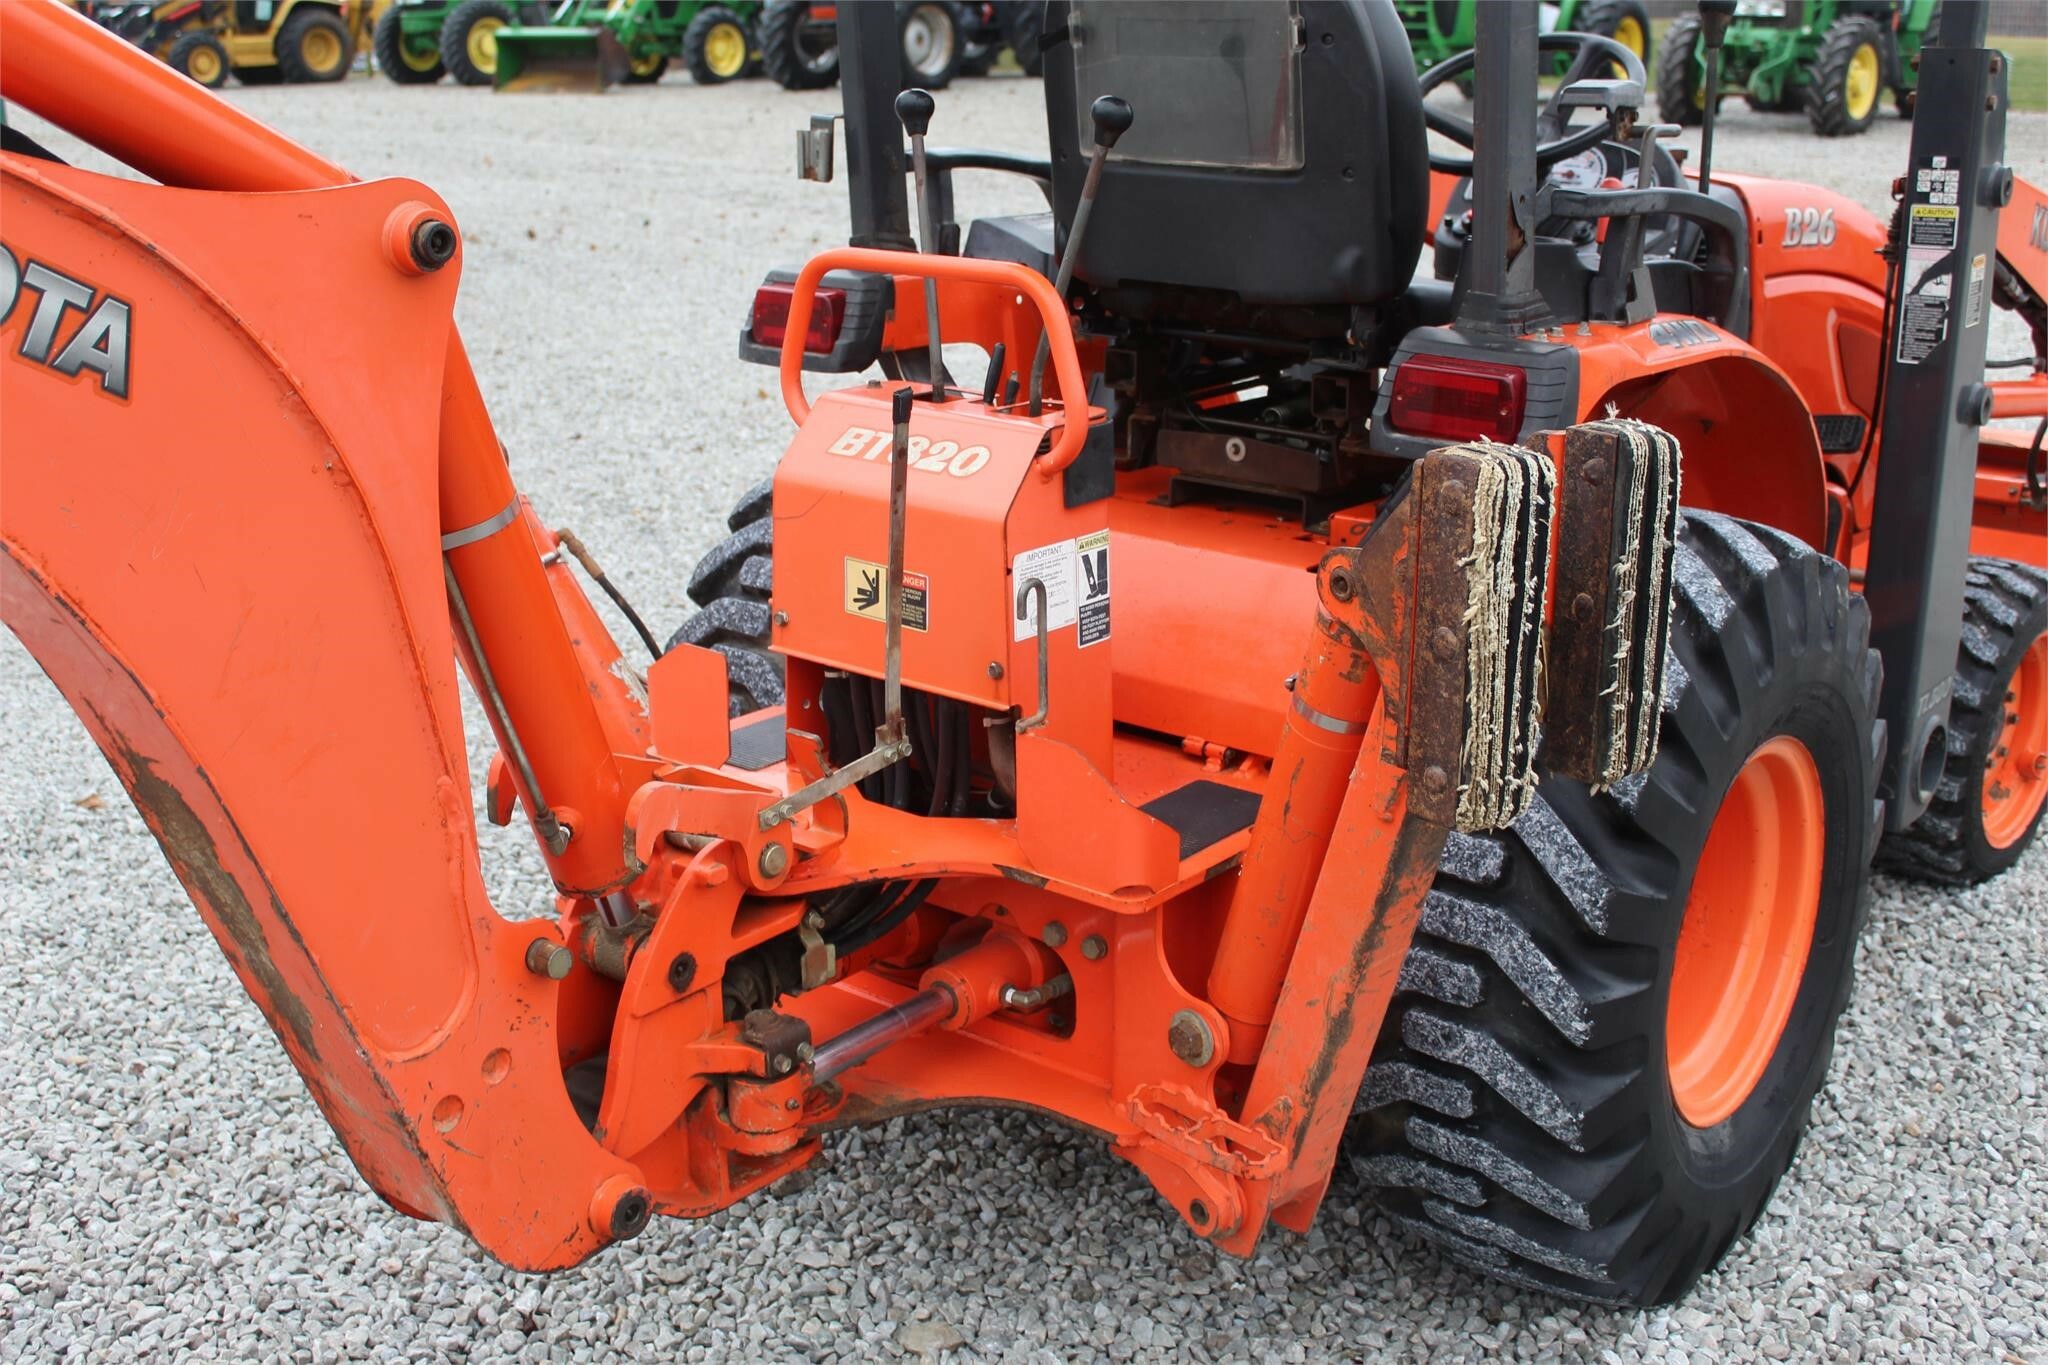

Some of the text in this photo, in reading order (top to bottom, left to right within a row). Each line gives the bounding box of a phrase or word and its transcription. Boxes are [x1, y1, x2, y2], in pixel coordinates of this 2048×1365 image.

[1921, 208, 1954, 216] CAUTION
[1782, 207, 1836, 247] B26
[826, 426, 991, 477] BT820
[1026, 545, 1062, 561] IMPORTANT
[902, 575, 926, 588] NGER
